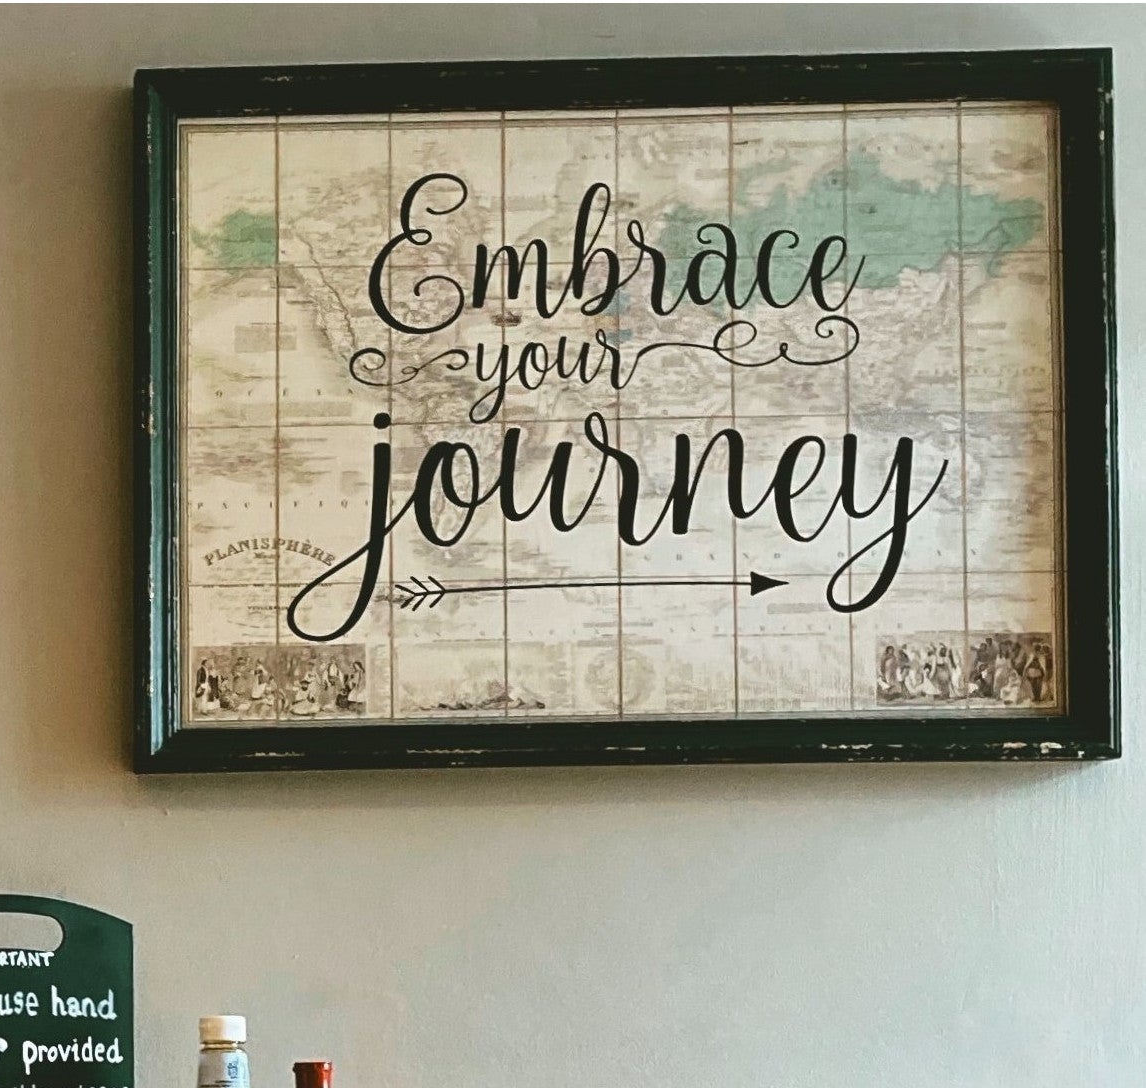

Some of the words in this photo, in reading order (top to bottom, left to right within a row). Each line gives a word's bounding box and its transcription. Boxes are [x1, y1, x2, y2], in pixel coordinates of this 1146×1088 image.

[369, 174, 865, 336] Embrace
[287, 412, 948, 642] journey
[51, 985, 118, 1021] hand
[22, 1035, 124, 1076] provided
